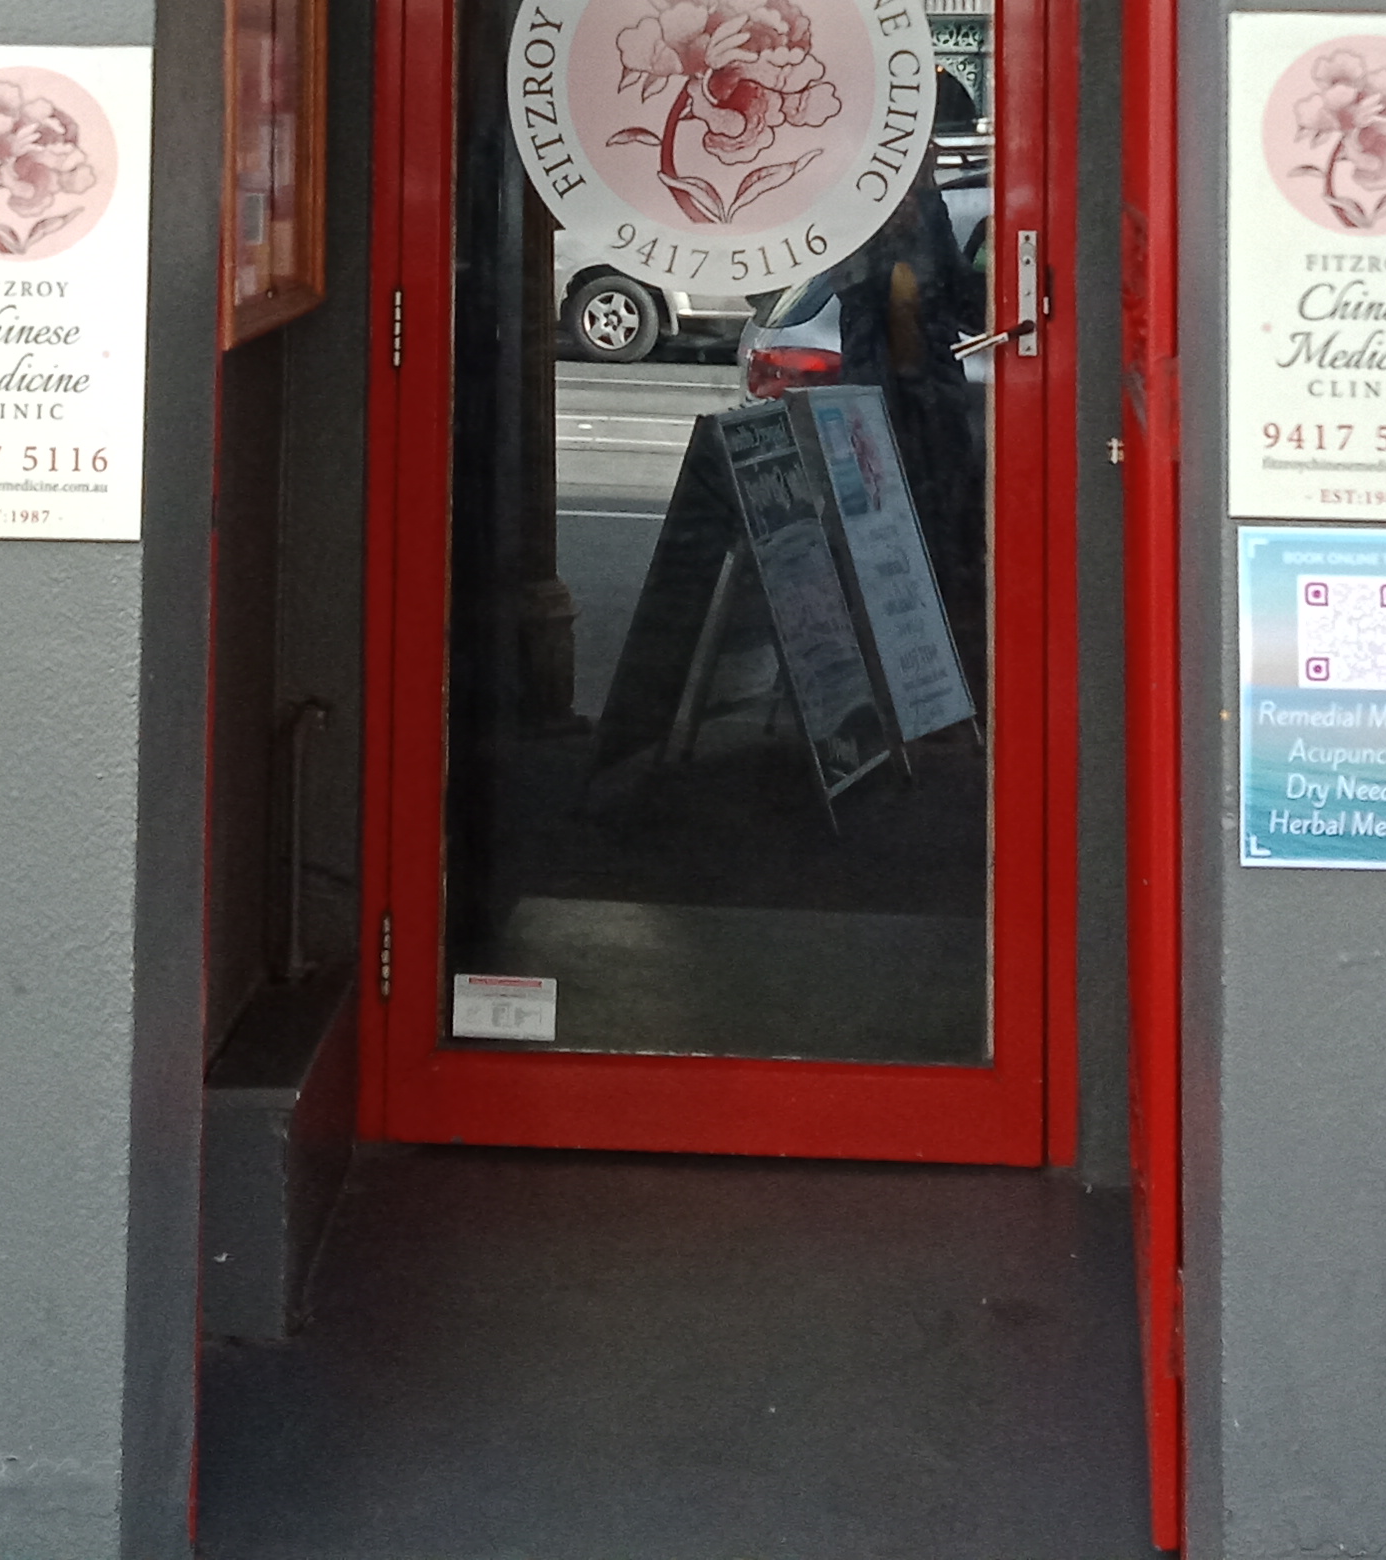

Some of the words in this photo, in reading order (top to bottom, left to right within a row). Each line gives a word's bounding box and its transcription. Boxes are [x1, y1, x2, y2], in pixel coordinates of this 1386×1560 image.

[524, 7, 587, 199] FITZROY
[856, 49, 919, 203] CLINIC
[612, 223, 709, 280] 9417
[731, 224, 828, 281] 5116
[1263, 422, 1355, 450] 9417
[22, 446, 108, 472] 5116
[1259, 700, 1360, 728] Remedial
[1286, 773, 1329, 808] Dry
[1269, 810, 1345, 836] Herbal
